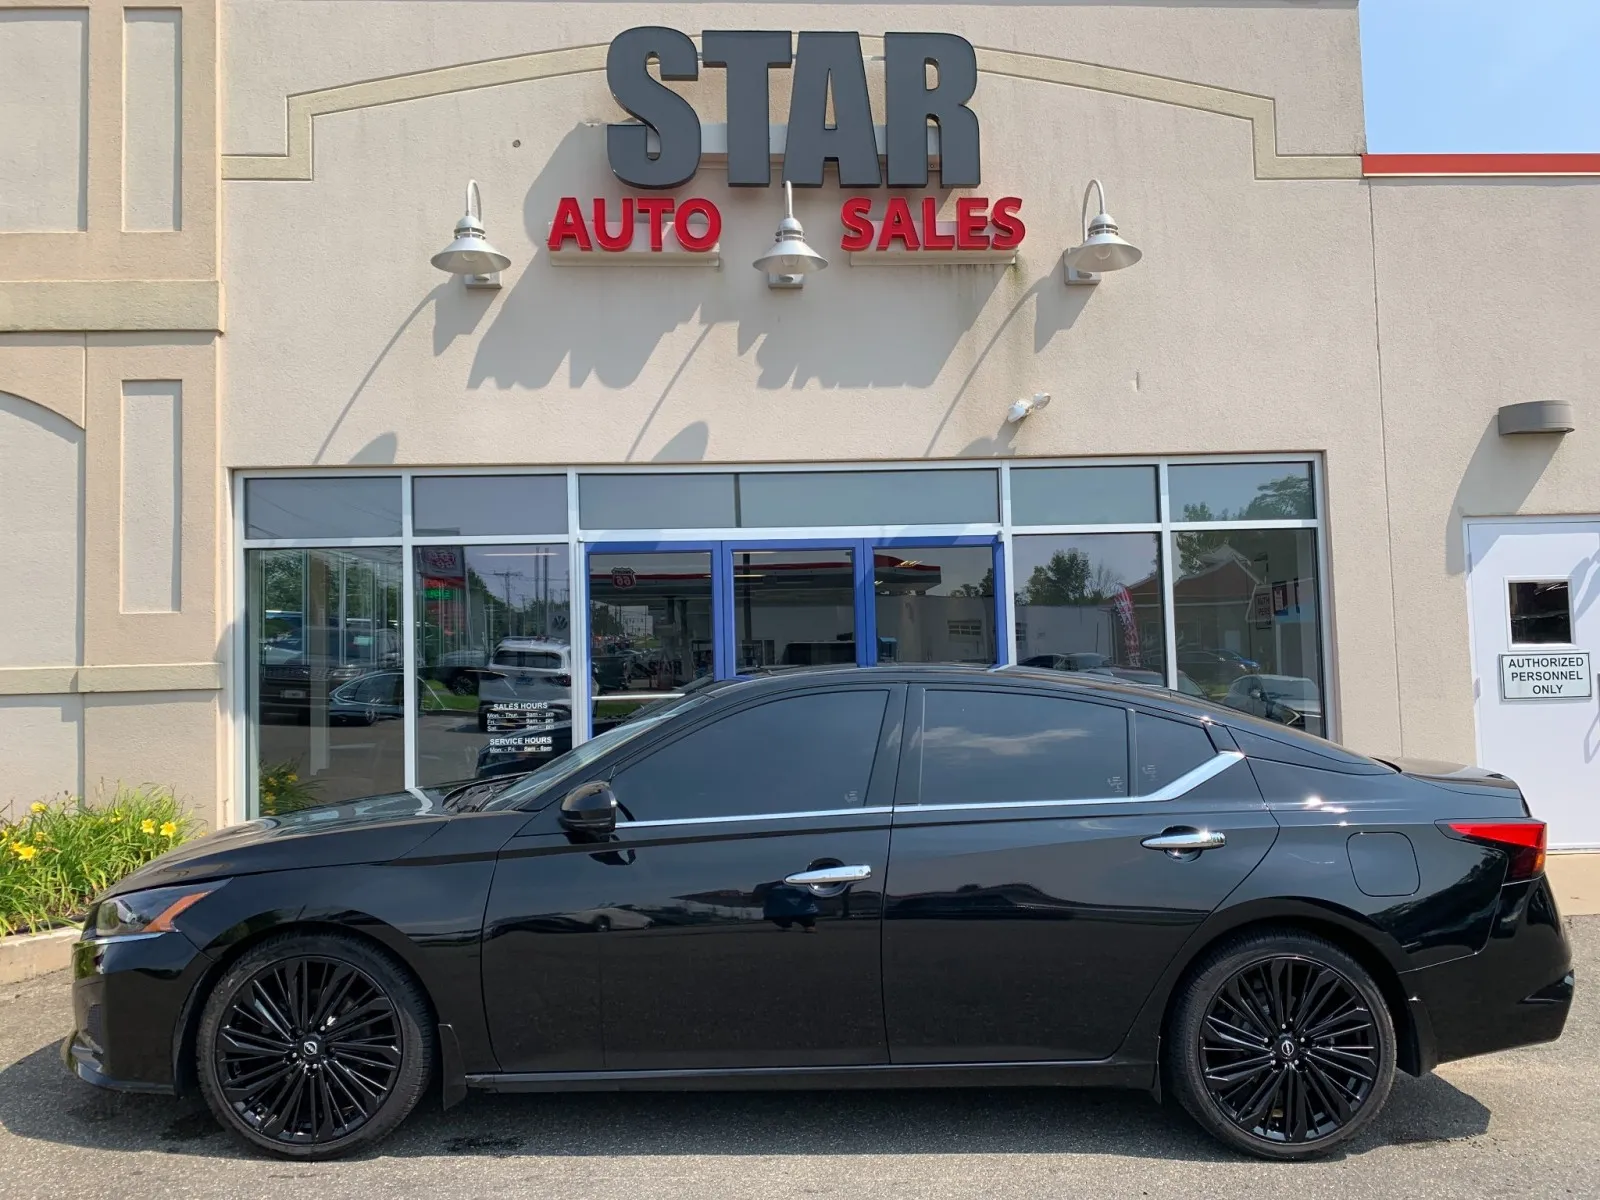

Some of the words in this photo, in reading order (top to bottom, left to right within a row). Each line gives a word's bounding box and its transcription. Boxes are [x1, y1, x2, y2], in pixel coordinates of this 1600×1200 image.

[606, 25, 981, 190] STAR
[547, 196, 723, 252] AUTO
[840, 196, 1026, 252] SALES
[1508, 657, 1584, 668] AUTHORIZED
[1511, 670, 1583, 681] PERSONNEL
[1532, 684, 1563, 694] ONLY
[524, 736, 552, 744] HOURS
